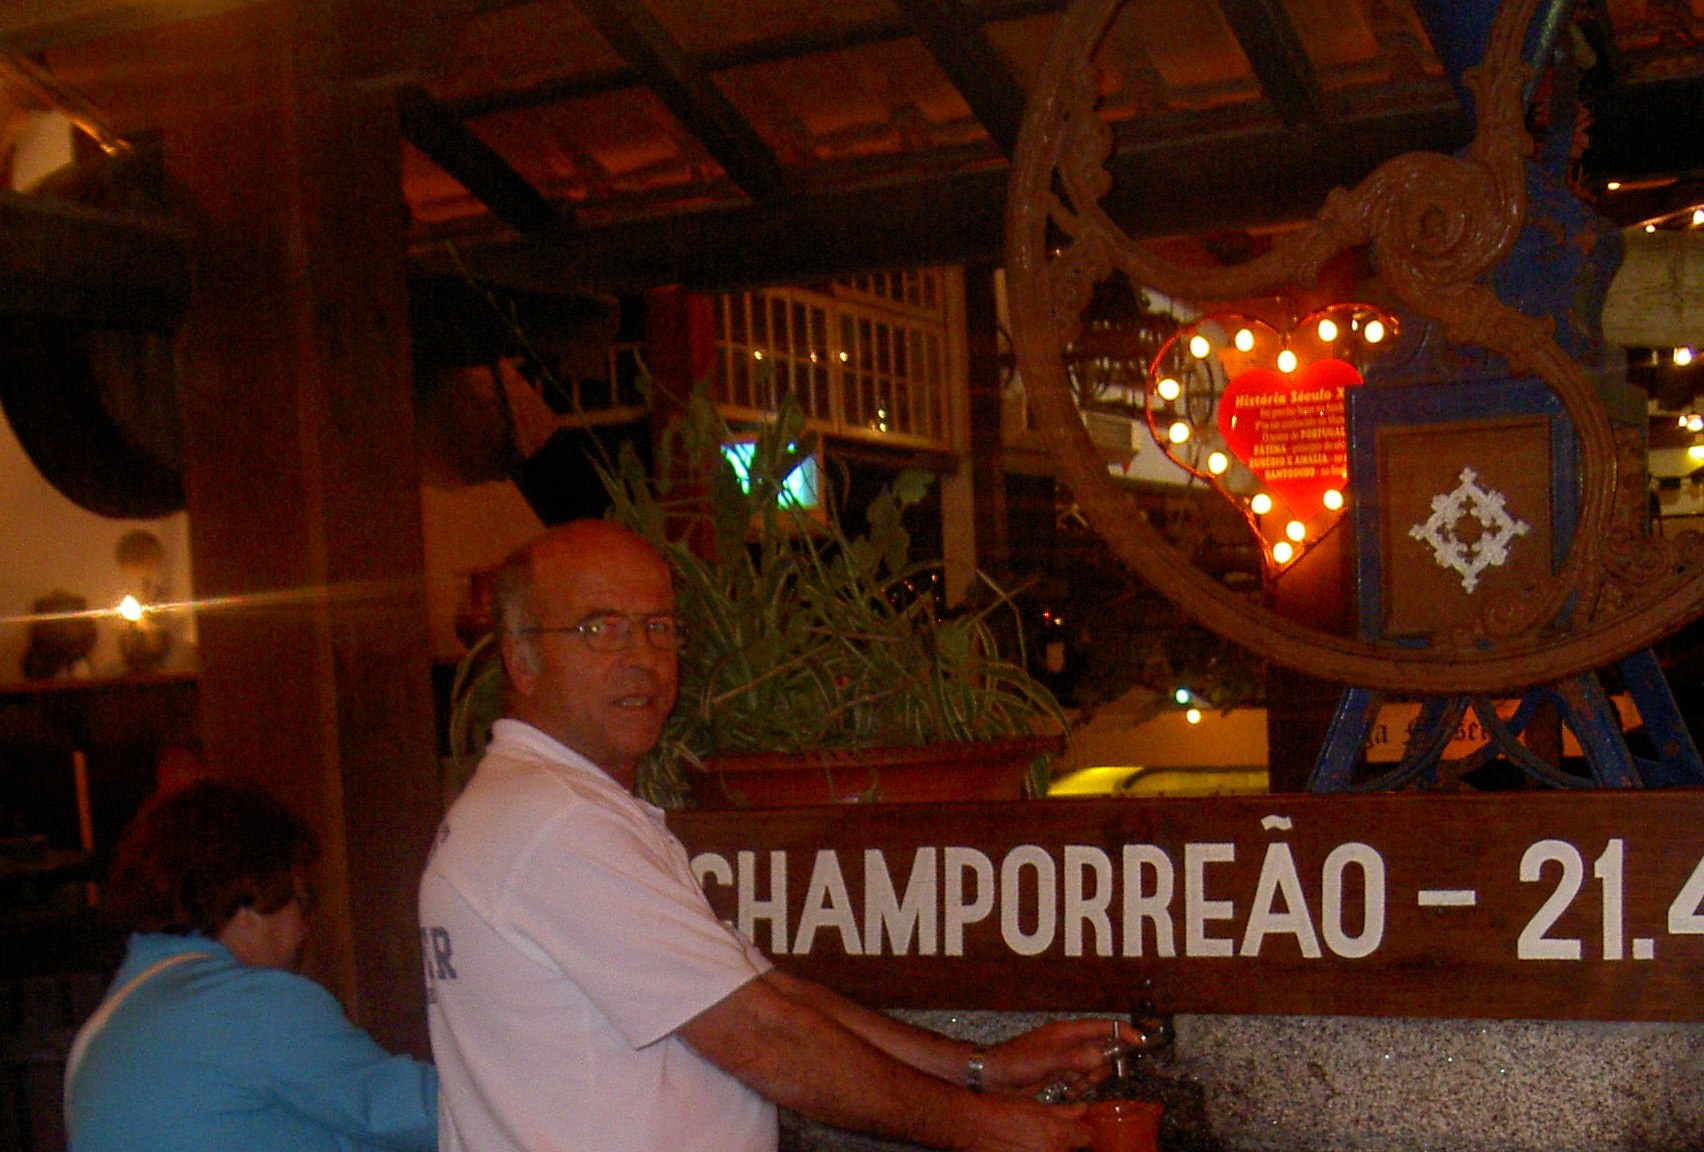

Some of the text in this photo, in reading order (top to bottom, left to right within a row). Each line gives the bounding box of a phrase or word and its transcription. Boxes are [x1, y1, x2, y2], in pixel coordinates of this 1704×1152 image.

[1235, 392, 1286, 408] História
[1290, 389, 1332, 403] Século
[690, 815, 1386, 958] CHAMPORREÃO
